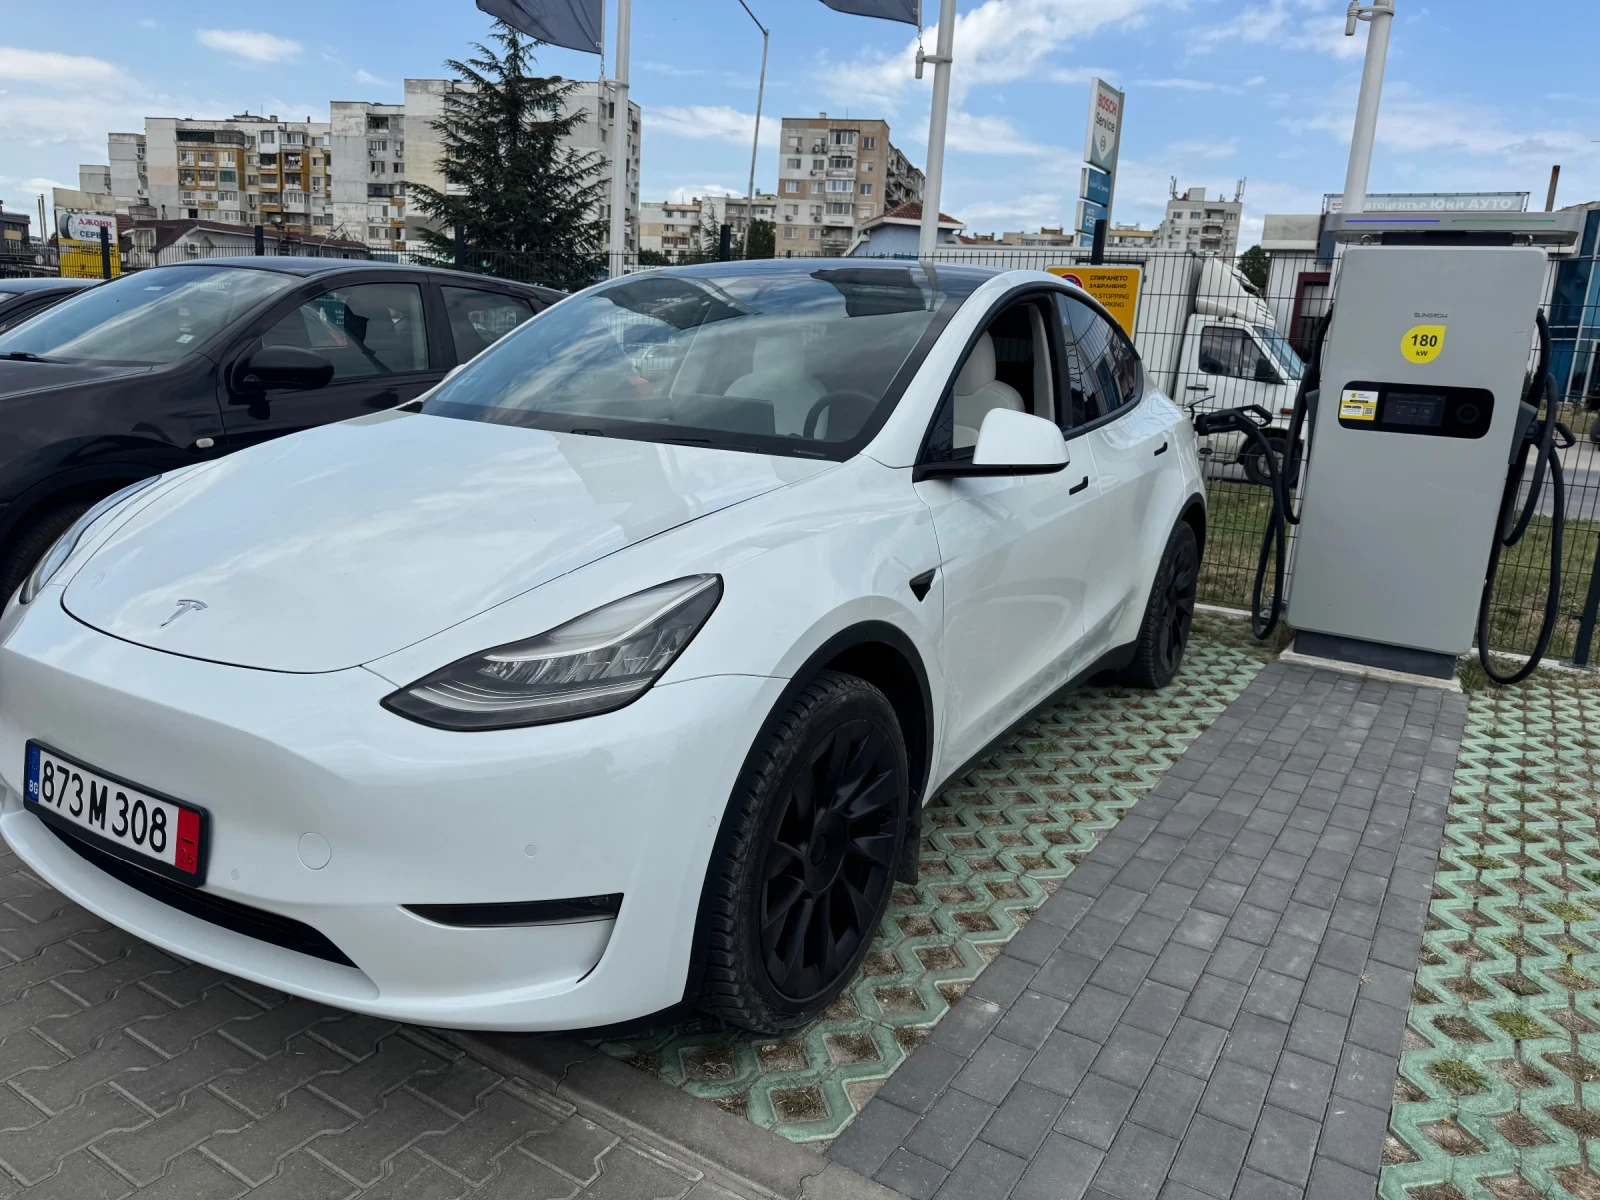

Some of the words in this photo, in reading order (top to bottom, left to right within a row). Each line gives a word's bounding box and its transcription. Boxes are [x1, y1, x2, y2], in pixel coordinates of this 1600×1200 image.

[1098, 93, 1117, 116] BOSCH
[1096, 112, 1115, 133] Service
[1365, 201, 1426, 210] ВТОЦЕНТЪР
[1430, 199, 1465, 209] Юни
[1468, 199, 1513, 209] АУТО
[80, 230, 113, 240] СЕРВЗ
[1411, 334, 1438, 347] 180
[29, 779, 39, 795] BG
[179, 848, 195, 866] 26
